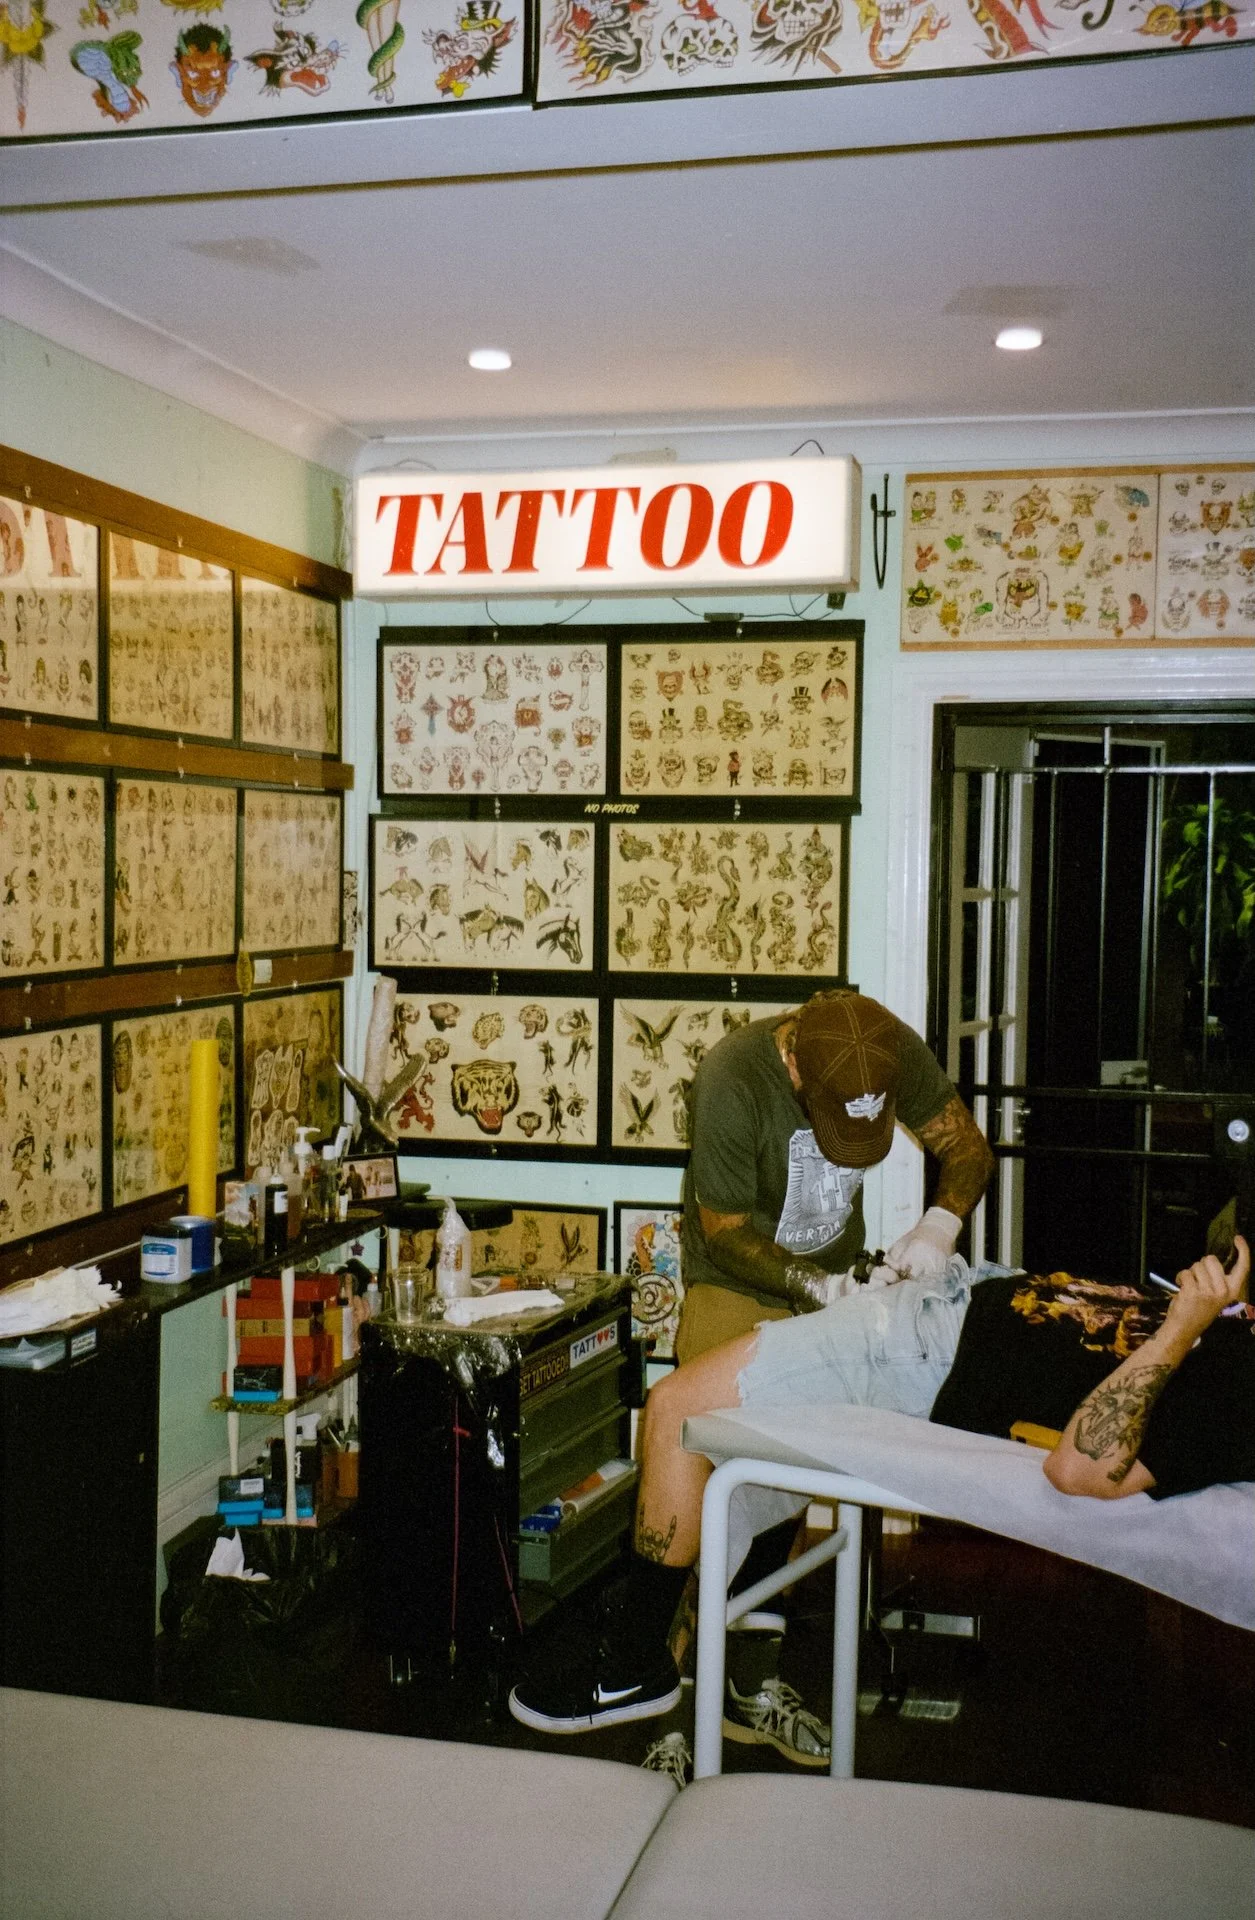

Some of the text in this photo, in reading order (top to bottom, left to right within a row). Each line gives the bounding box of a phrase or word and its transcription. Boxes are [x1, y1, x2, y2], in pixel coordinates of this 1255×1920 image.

[376, 481, 794, 576] TATTOO
[584, 803, 640, 814] NO PHOTOS
